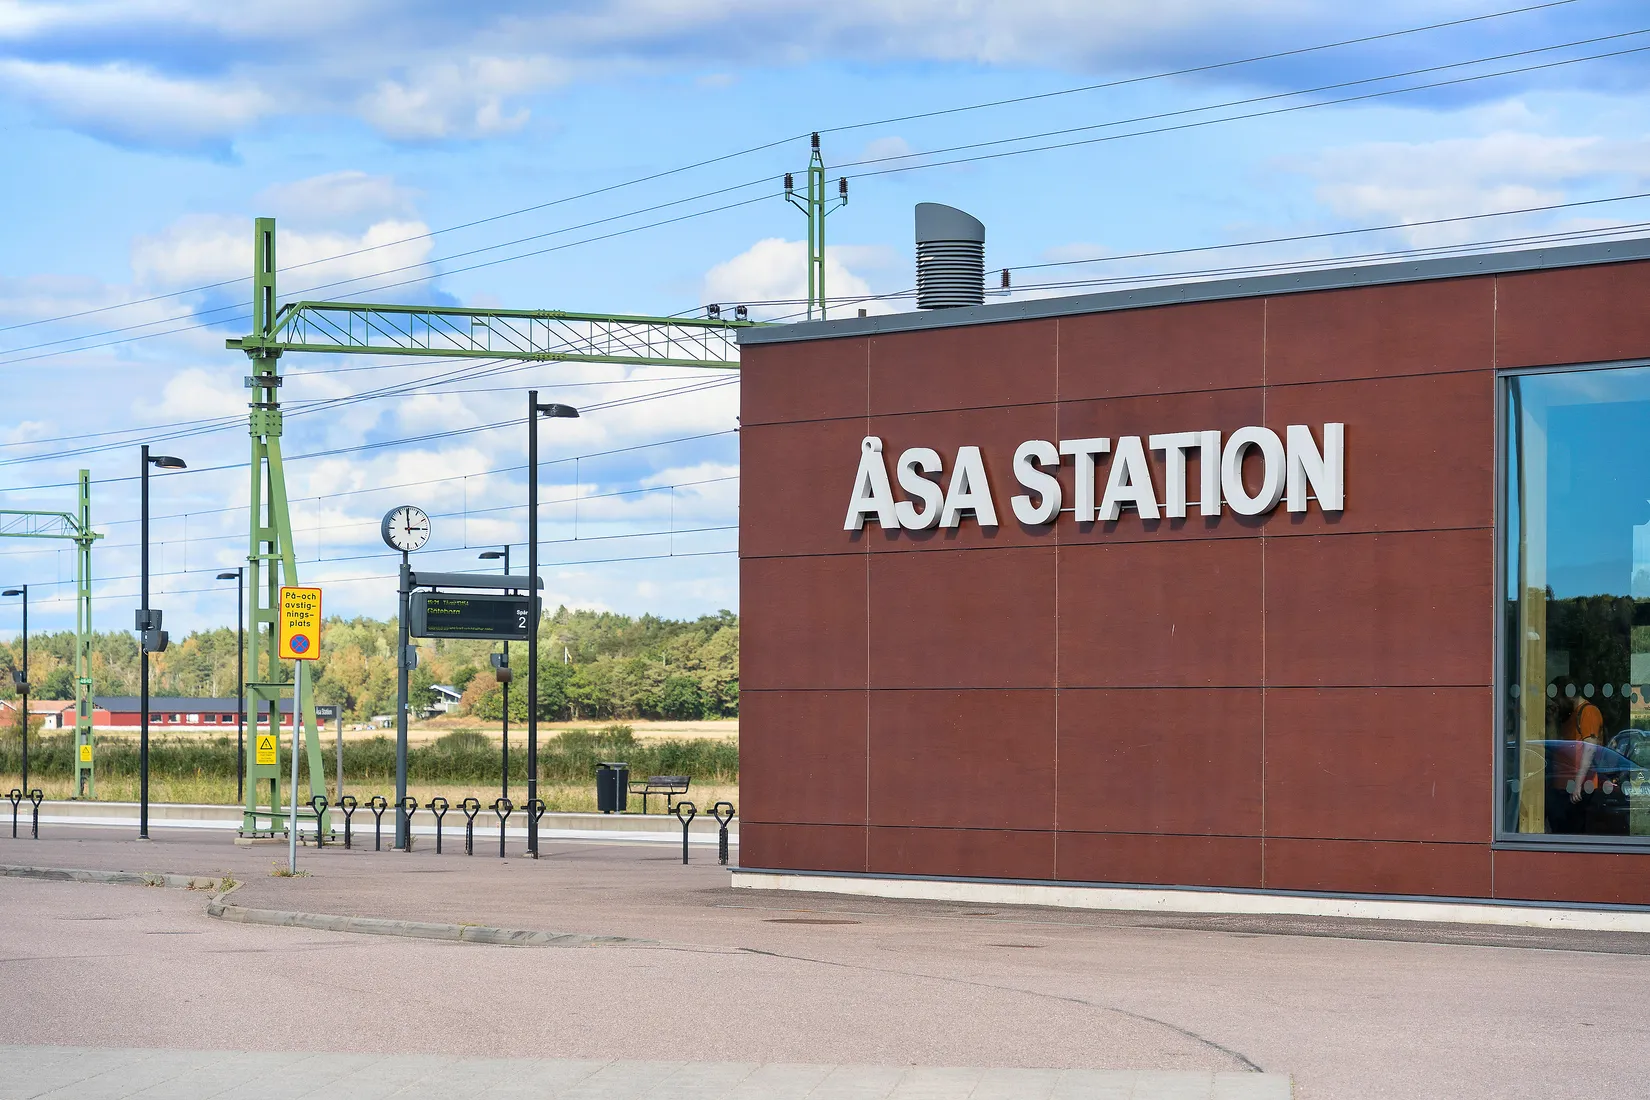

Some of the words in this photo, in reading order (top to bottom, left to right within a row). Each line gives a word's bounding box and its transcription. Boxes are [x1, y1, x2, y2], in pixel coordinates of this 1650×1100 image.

[844, 436, 998, 530] ÅSA
[1010, 422, 1345, 526] STATION
[285, 602, 316, 610] avstig-
[286, 611, 314, 619] nings-
[290, 620, 311, 628] plats
[518, 616, 527, 629] 2
